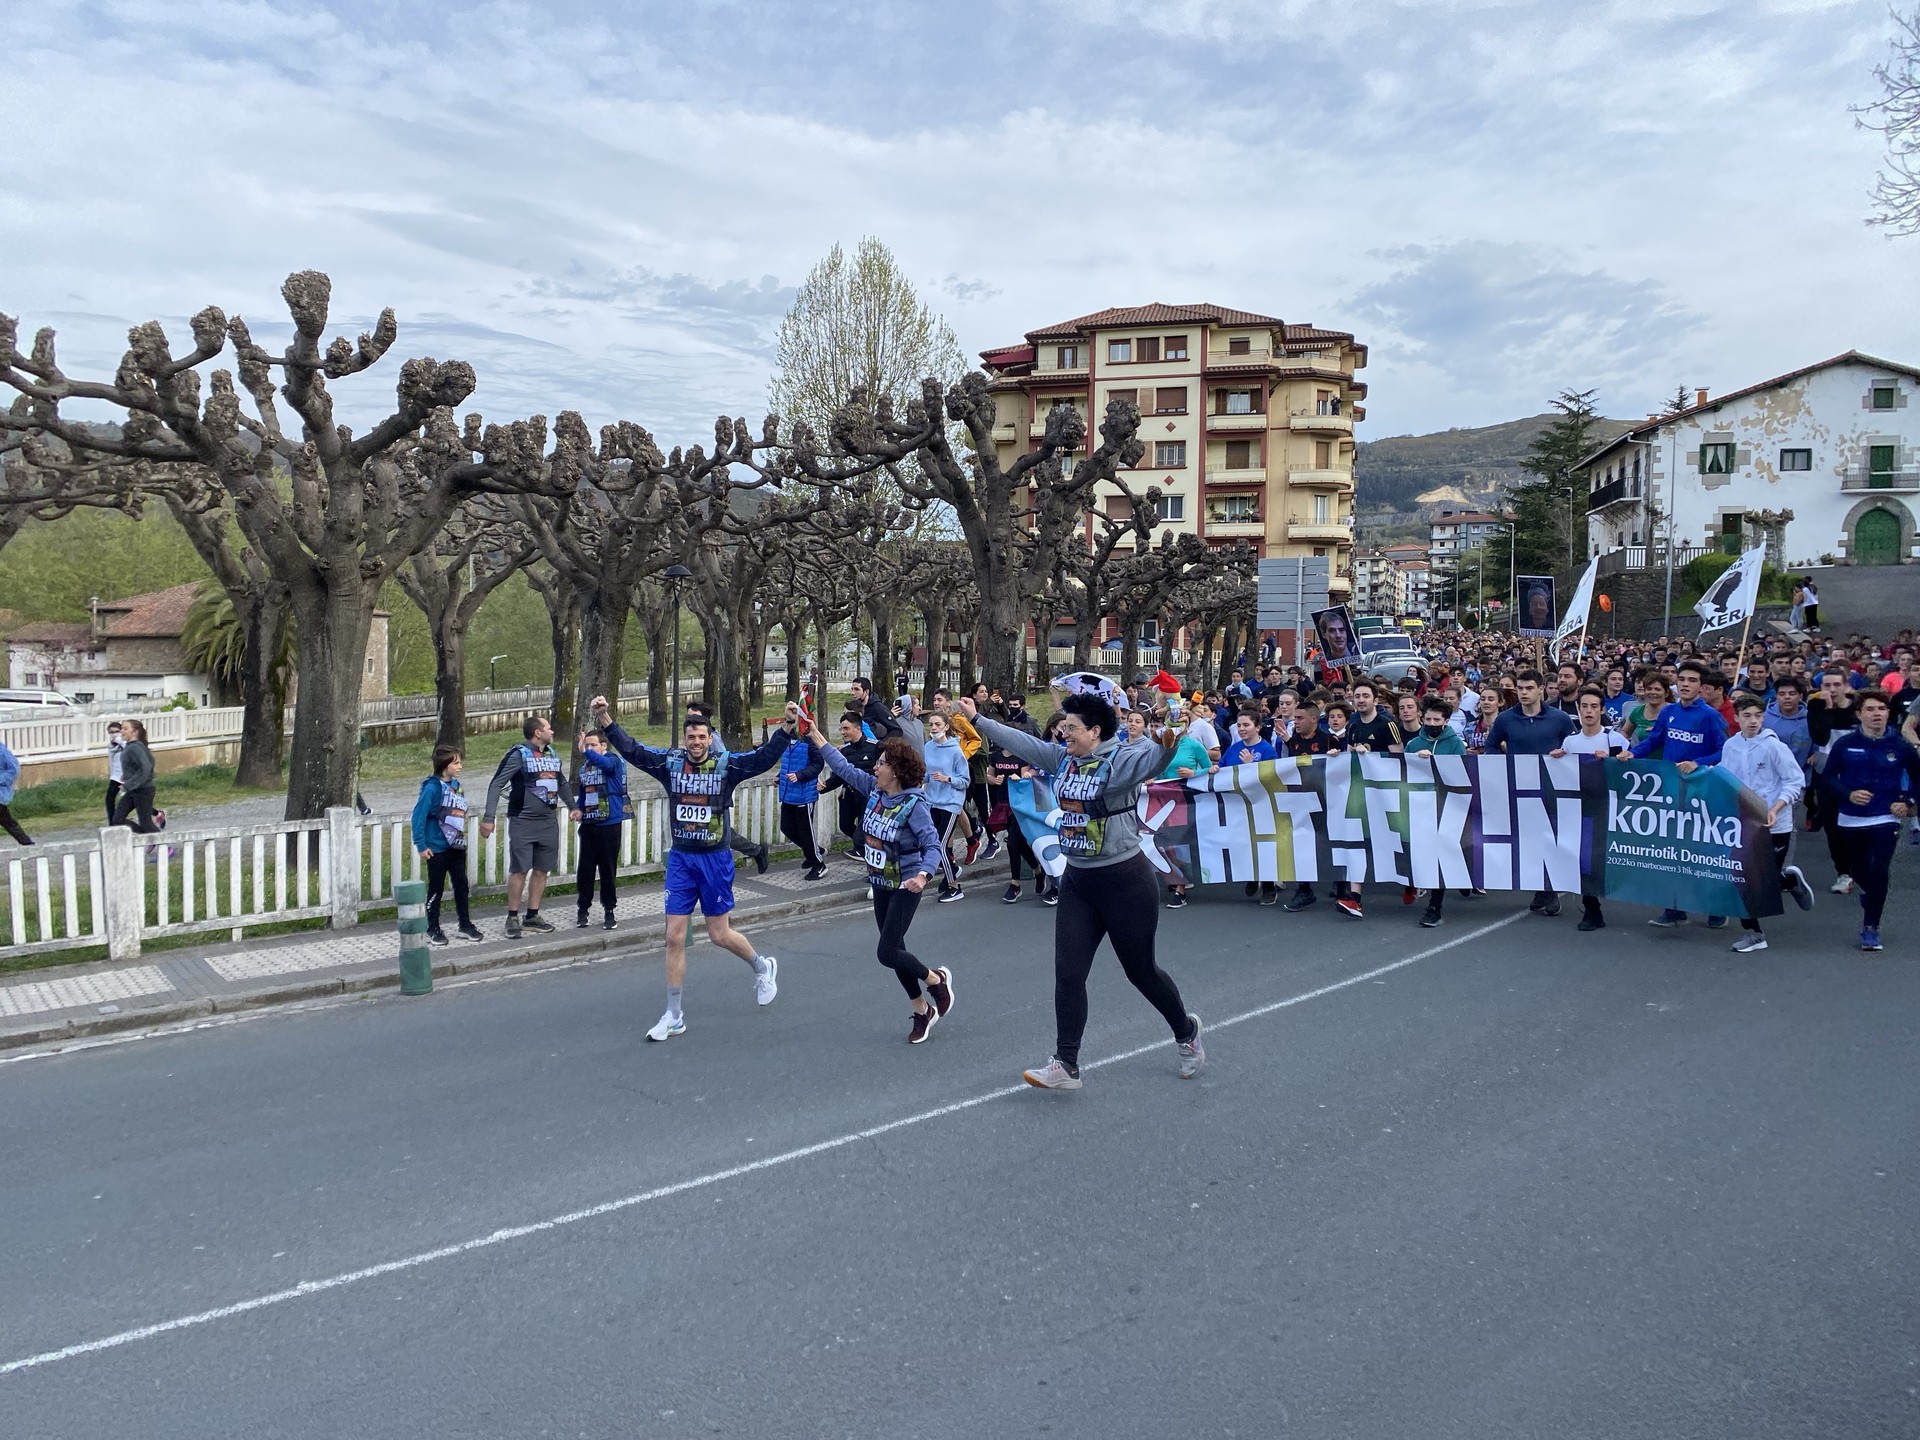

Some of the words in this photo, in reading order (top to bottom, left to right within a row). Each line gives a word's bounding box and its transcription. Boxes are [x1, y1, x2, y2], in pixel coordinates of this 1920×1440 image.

[1667, 730, 1704, 743] oodBall
[1622, 771, 1673, 804] 22.
[680, 806, 706, 820] 2019
[1608, 789, 1743, 849] korrika
[1606, 856, 1636, 867] 2022ko
[1608, 840, 1678, 861] Amurriotik
[1681, 849, 1743, 871] Donostiara
